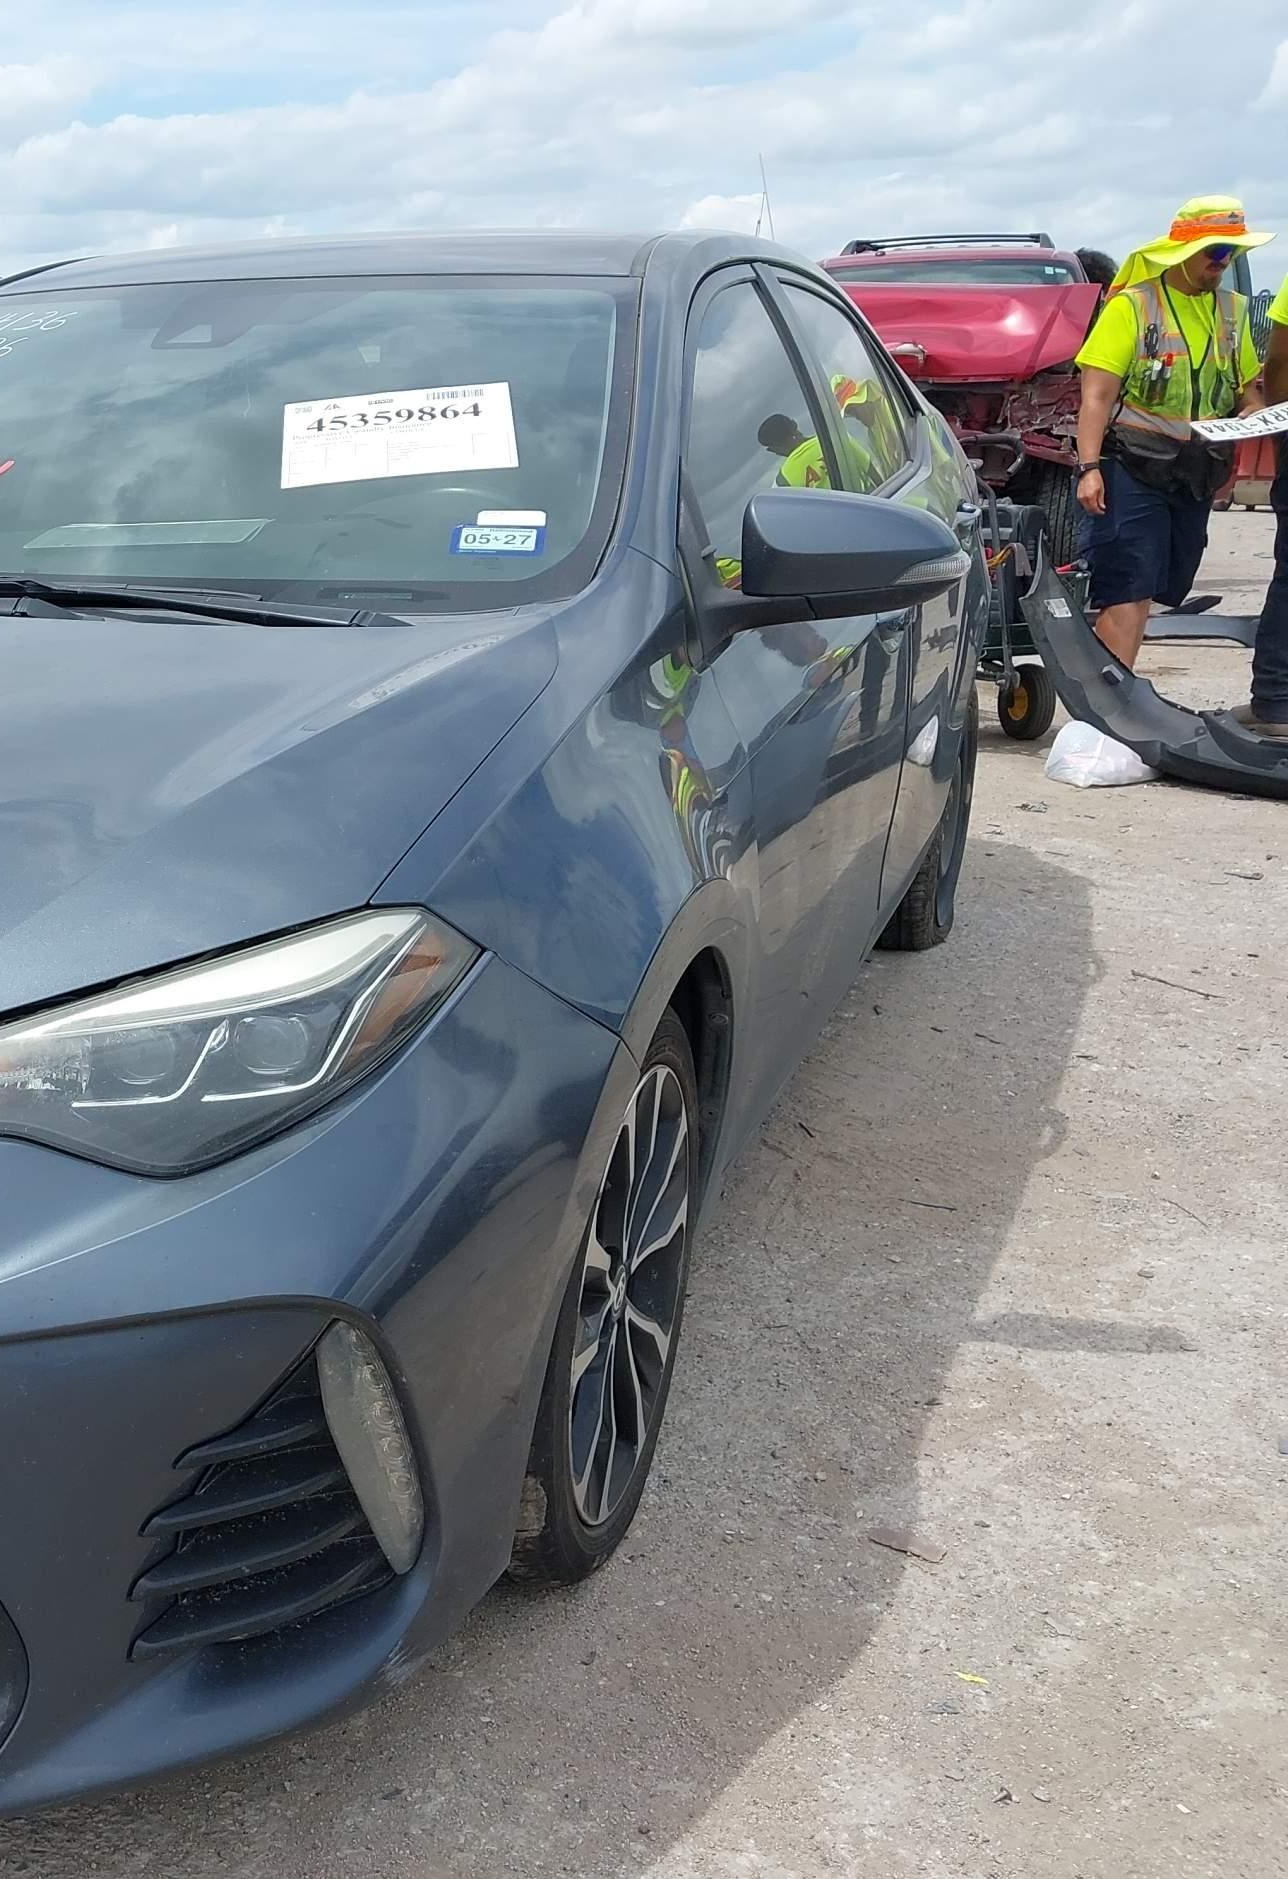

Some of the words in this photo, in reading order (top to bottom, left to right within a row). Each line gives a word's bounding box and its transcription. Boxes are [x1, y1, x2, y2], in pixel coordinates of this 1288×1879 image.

[306, 402, 482, 432] 45359864
[464, 532, 491, 545] 05
[502, 534, 532, 546] 27
